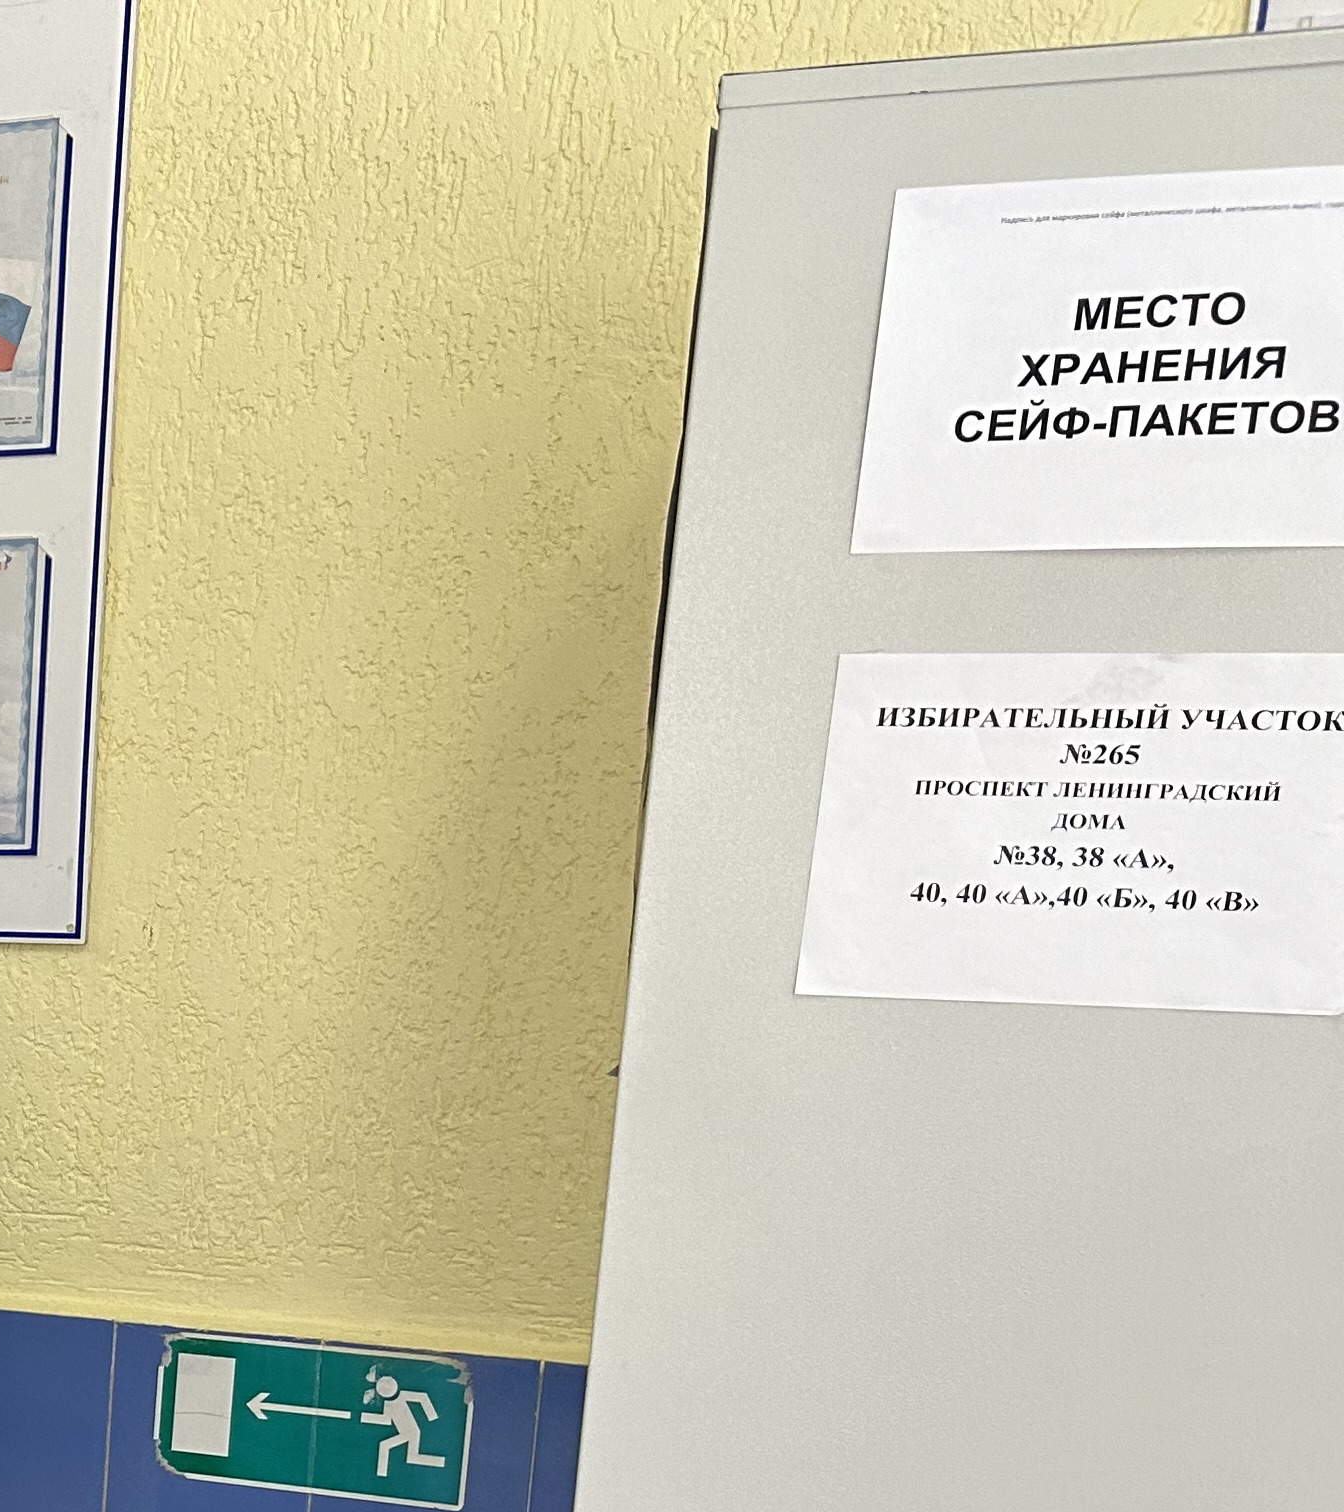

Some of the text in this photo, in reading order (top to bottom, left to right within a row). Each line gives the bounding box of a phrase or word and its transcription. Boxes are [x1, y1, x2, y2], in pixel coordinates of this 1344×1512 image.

[1073, 292, 1247, 331] МЕСТО
[1017, 346, 1287, 387] ХРАНЕНИЯ
[954, 399, 1341, 442] СЕЙФ-ПАКЕТОВ
[876, 703, 1344, 732] ИЗБИРАТЕЛЬНЫЙ УЧАСТОК
[1060, 743, 1141, 766] №265
[914, 779, 1282, 804] ПРОСПЕКТ ЛЕНИНГРАДСКИЙ
[1051, 812, 1126, 831] ДОМА
[993, 845, 1175, 873] №38, 38 «А»,
[909, 882, 947, 906] 40,
[956, 883, 987, 904] 40
[1096, 887, 1156, 913] «Б»,
[1165, 889, 1197, 912] 40
[1205, 890, 1259, 913] «В»
